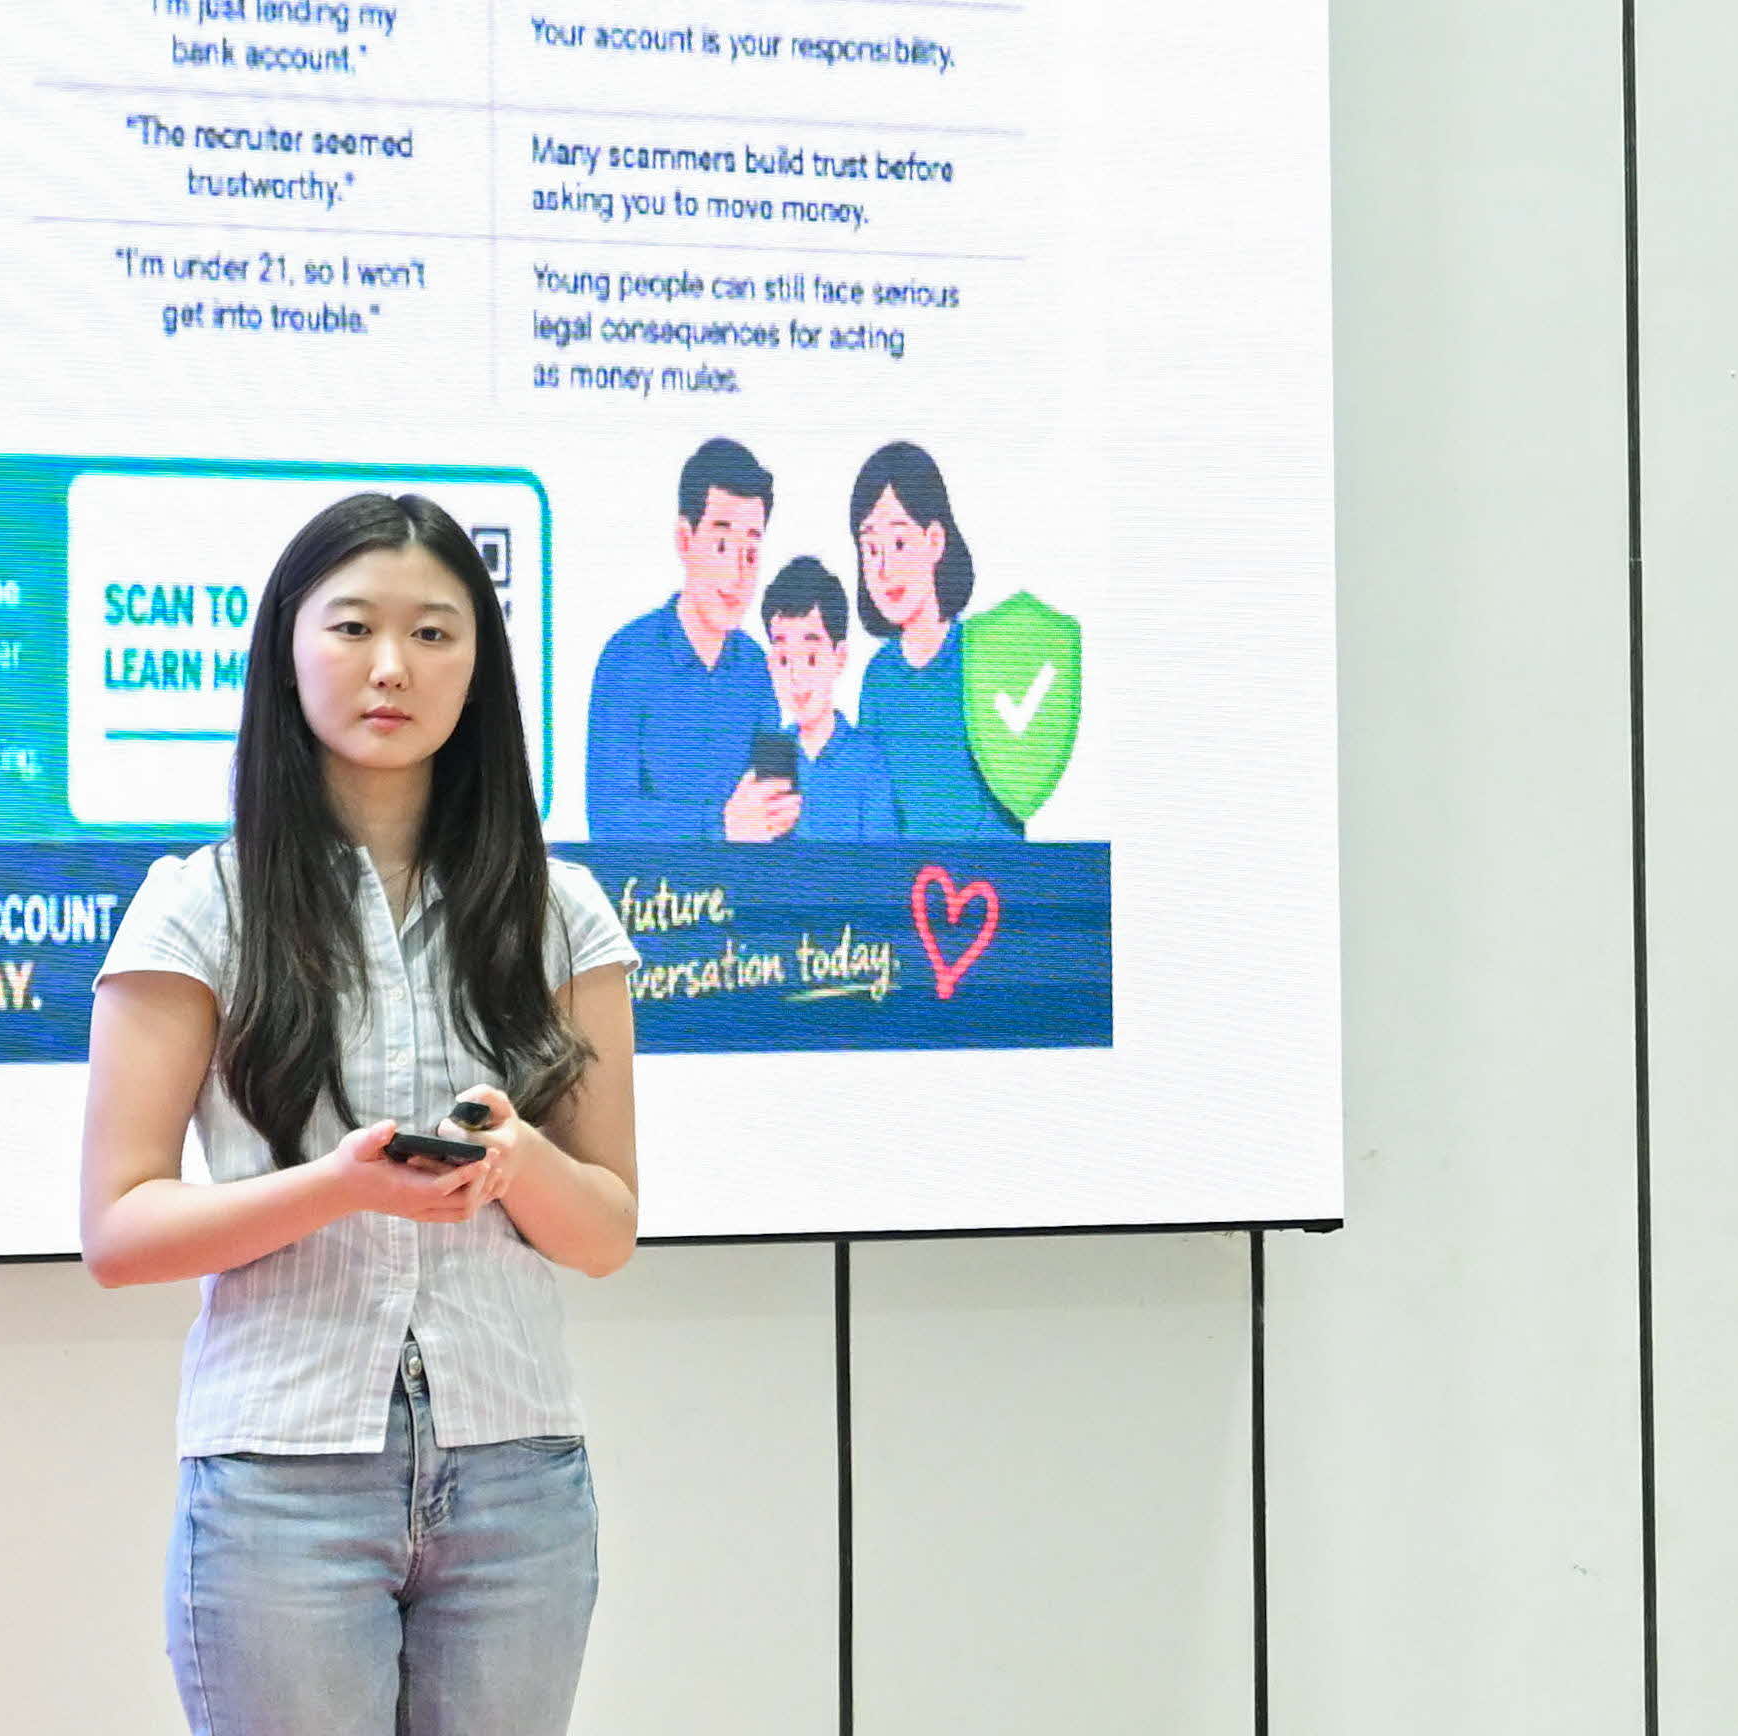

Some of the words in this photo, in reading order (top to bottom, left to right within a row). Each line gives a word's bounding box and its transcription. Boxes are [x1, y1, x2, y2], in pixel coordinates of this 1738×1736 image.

[359, 5, 397, 37] my
[531, 16, 585, 48] Your
[594, 26, 695, 55] account
[702, 28, 721, 55] is
[730, 34, 783, 62] your
[172, 34, 236, 67] bank
[194, 122, 304, 152] recruiter
[312, 128, 414, 159] seemed
[532, 132, 601, 177] Many
[608, 144, 737, 175] scammers
[745, 144, 805, 177] build
[813, 150, 868, 180] trust
[876, 149, 954, 184] before
[532, 181, 614, 222] asking
[621, 191, 666, 222] you
[674, 189, 699, 217] to
[708, 197, 774, 222] move
[173, 251, 249, 283] under
[304, 260, 335, 287] so
[532, 261, 612, 304] Young
[619, 269, 705, 305] people
[711, 276, 757, 301] can
[765, 273, 806, 305] still
[815, 274, 864, 305] face
[872, 279, 960, 310] serious
[162, 302, 205, 338] get
[212, 301, 263, 331] into
[532, 308, 593, 348] legal
[600, 315, 781, 352] consequences
[790, 318, 823, 350] for
[829, 322, 907, 360] acting
[532, 362, 561, 390] as
[570, 362, 654, 400] money
[104, 582, 195, 628] SCAN
[205, 583, 249, 628] TO
[104, 647, 203, 691] LEARN
[213, 648, 250, 691] M
[631, 937, 785, 1001] versation
[795, 923, 901, 1002] today.
